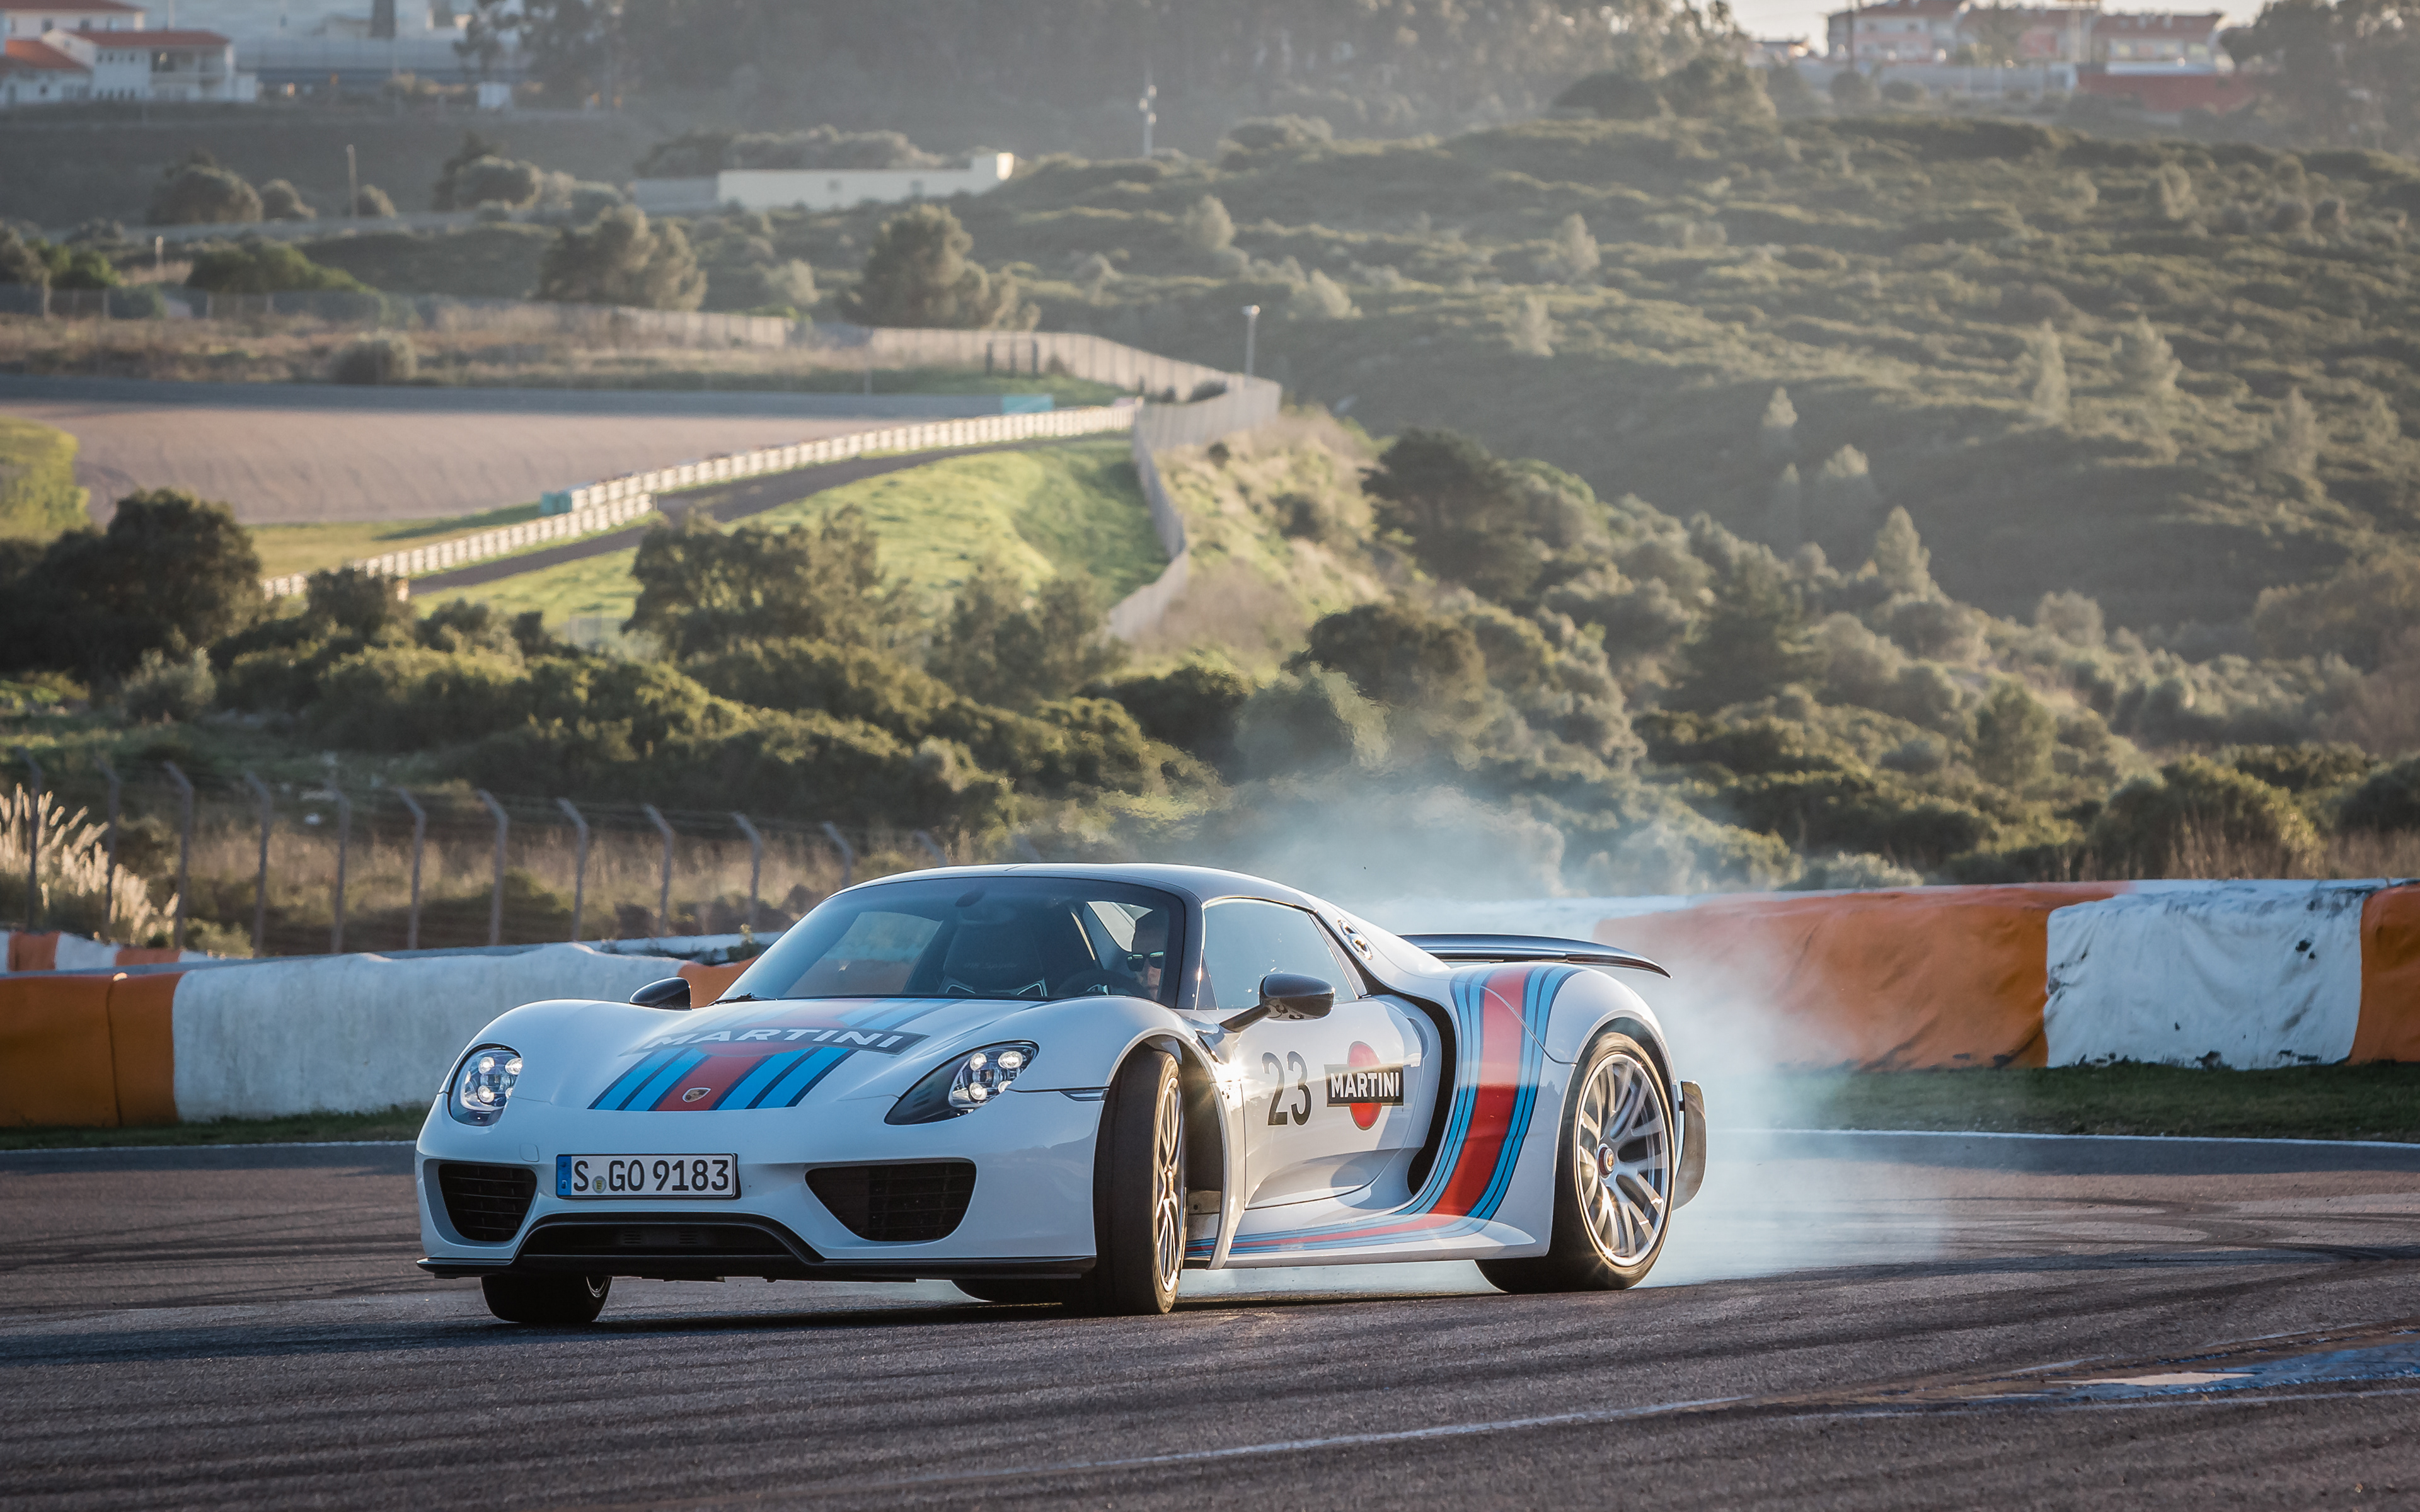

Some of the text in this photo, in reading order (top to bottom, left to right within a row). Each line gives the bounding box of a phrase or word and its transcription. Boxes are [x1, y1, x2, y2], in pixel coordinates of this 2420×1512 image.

[643, 1029, 903, 1049] MARTINI
[1262, 1051, 1312, 1126] 23
[1330, 1072, 1400, 1097] MARTINI
[573, 1159, 729, 1192] S GO 9183
